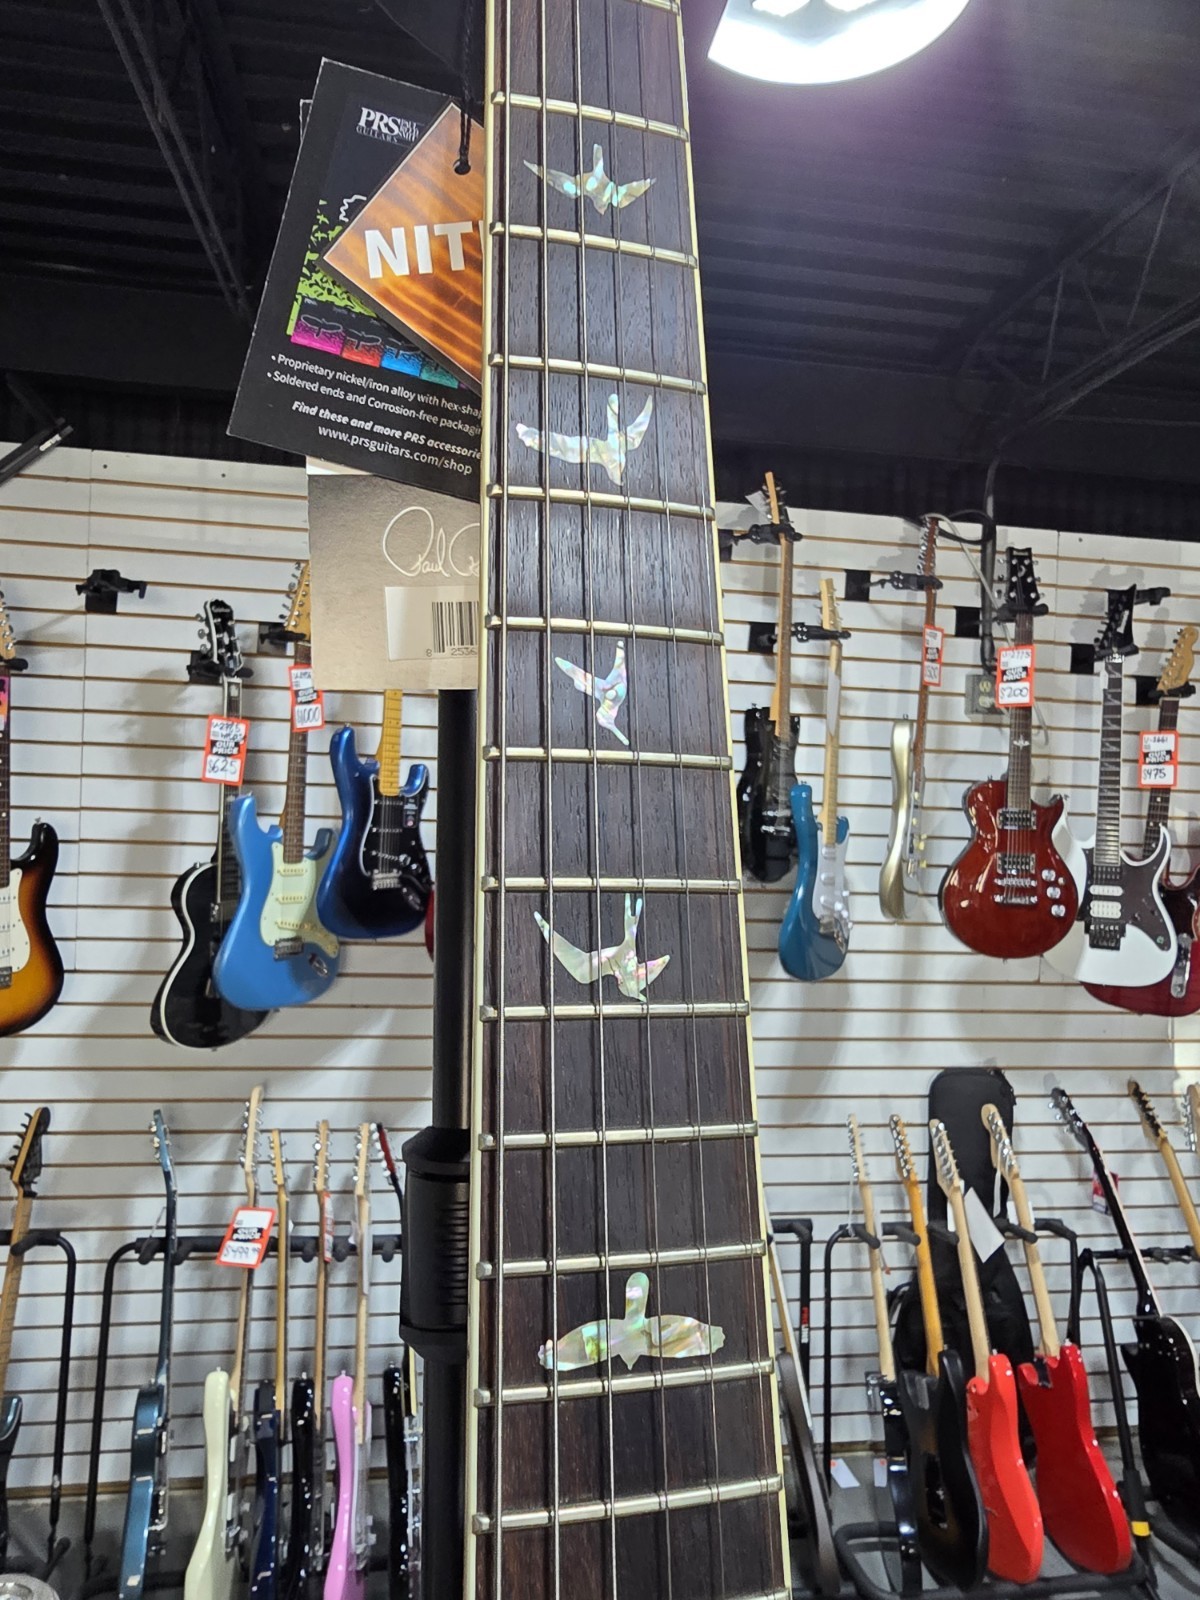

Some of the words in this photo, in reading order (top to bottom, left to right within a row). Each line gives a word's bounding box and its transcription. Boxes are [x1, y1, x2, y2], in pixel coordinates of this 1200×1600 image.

[358, 107, 401, 136] PRS
[364, 219, 484, 279] NIT
[277, 353, 335, 380] Proprietary
[336, 371, 390, 393] nickel/iron
[391, 386, 416, 402] alloy
[417, 393, 440, 406] with
[273, 370, 319, 392] Soldered
[320, 385, 345, 399] ends
[346, 392, 366, 405] and
[367, 397, 439, 425] Corrosion-free
[292, 400, 318, 416] Find
[318, 408, 349, 425] these
[350, 418, 373, 431] and
[373, 424, 402, 439] more
[403, 431, 426, 445] PRS
[318, 425, 472, 476] www.prsguitars.com/shop
[425, 648, 433, 658] 8
[1000, 686, 1028, 700] $200
[212, 747, 239, 755] PRICE
[215, 740, 235, 749] OUR
[207, 758, 238, 775] $625
